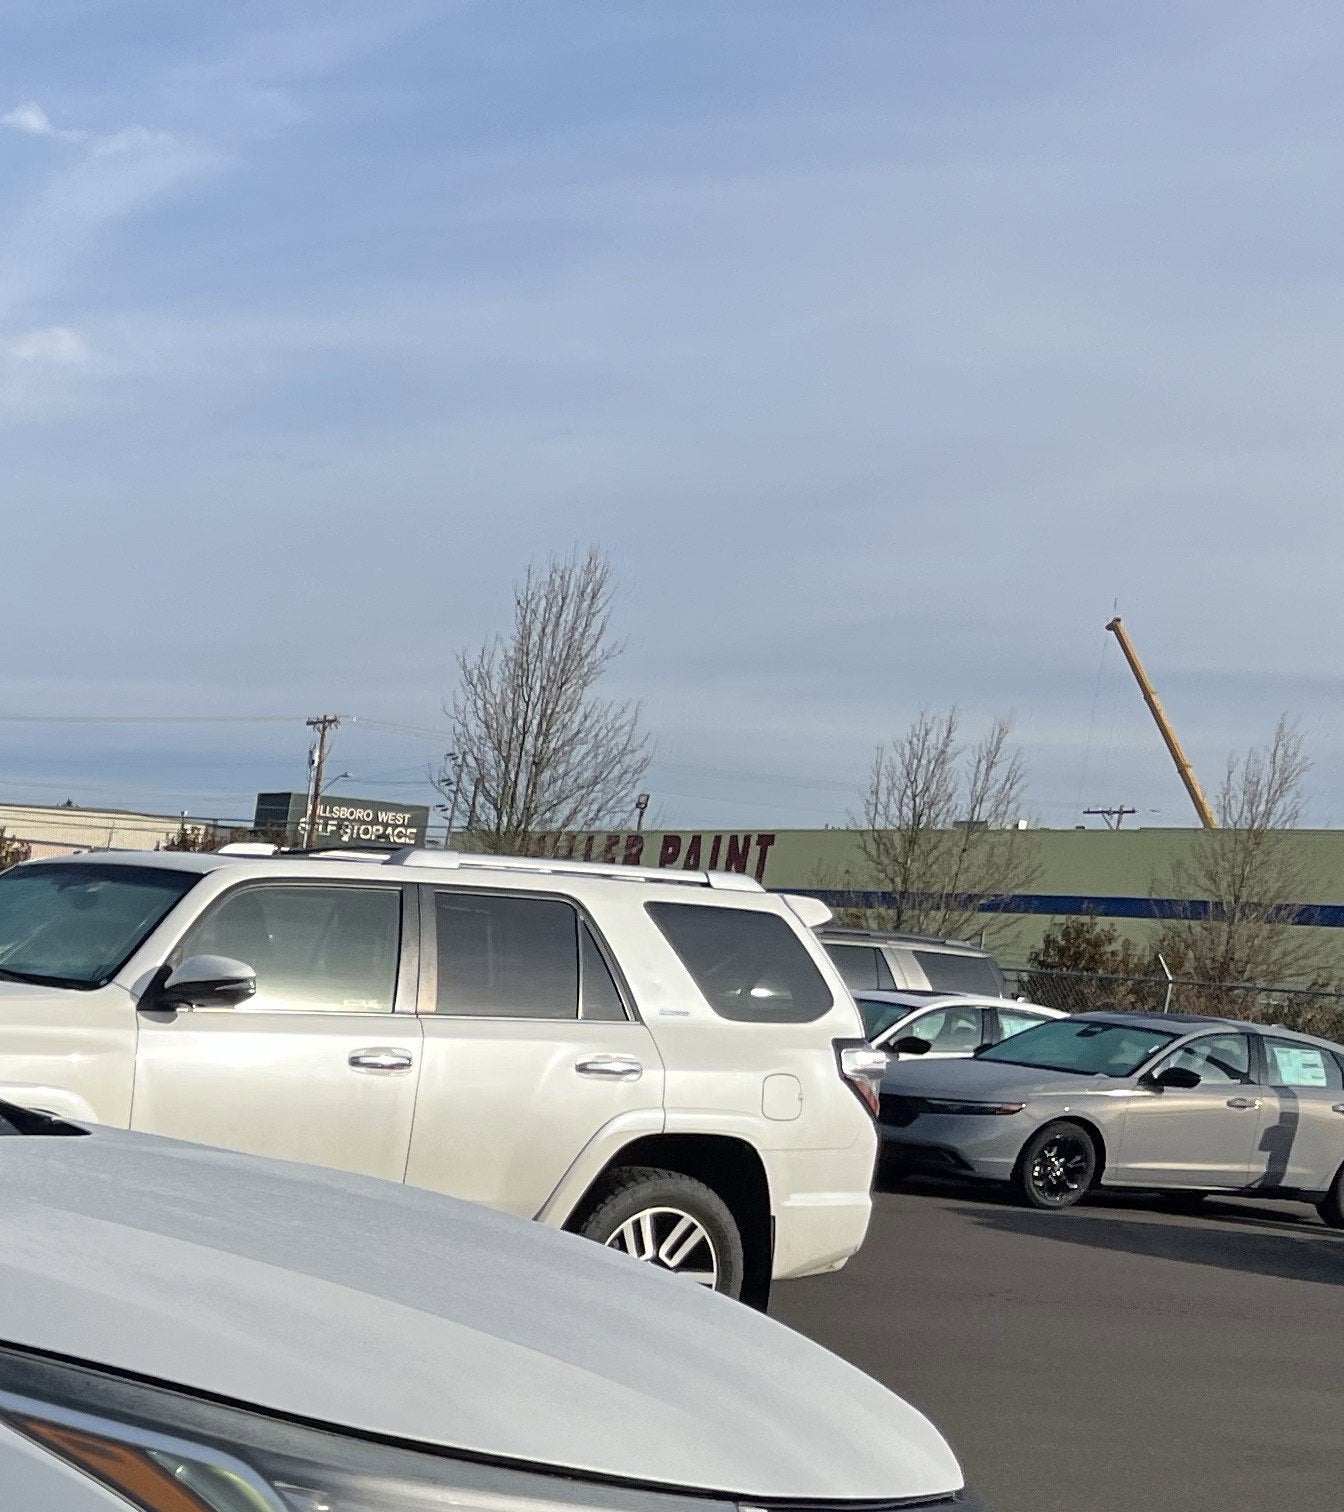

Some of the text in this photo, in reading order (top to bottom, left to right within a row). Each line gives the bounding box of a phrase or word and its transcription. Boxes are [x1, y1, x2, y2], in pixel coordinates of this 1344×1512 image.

[378, 811, 411, 826] WEST
[340, 821, 418, 845] STORAGE
[659, 833, 775, 884] PAINT
